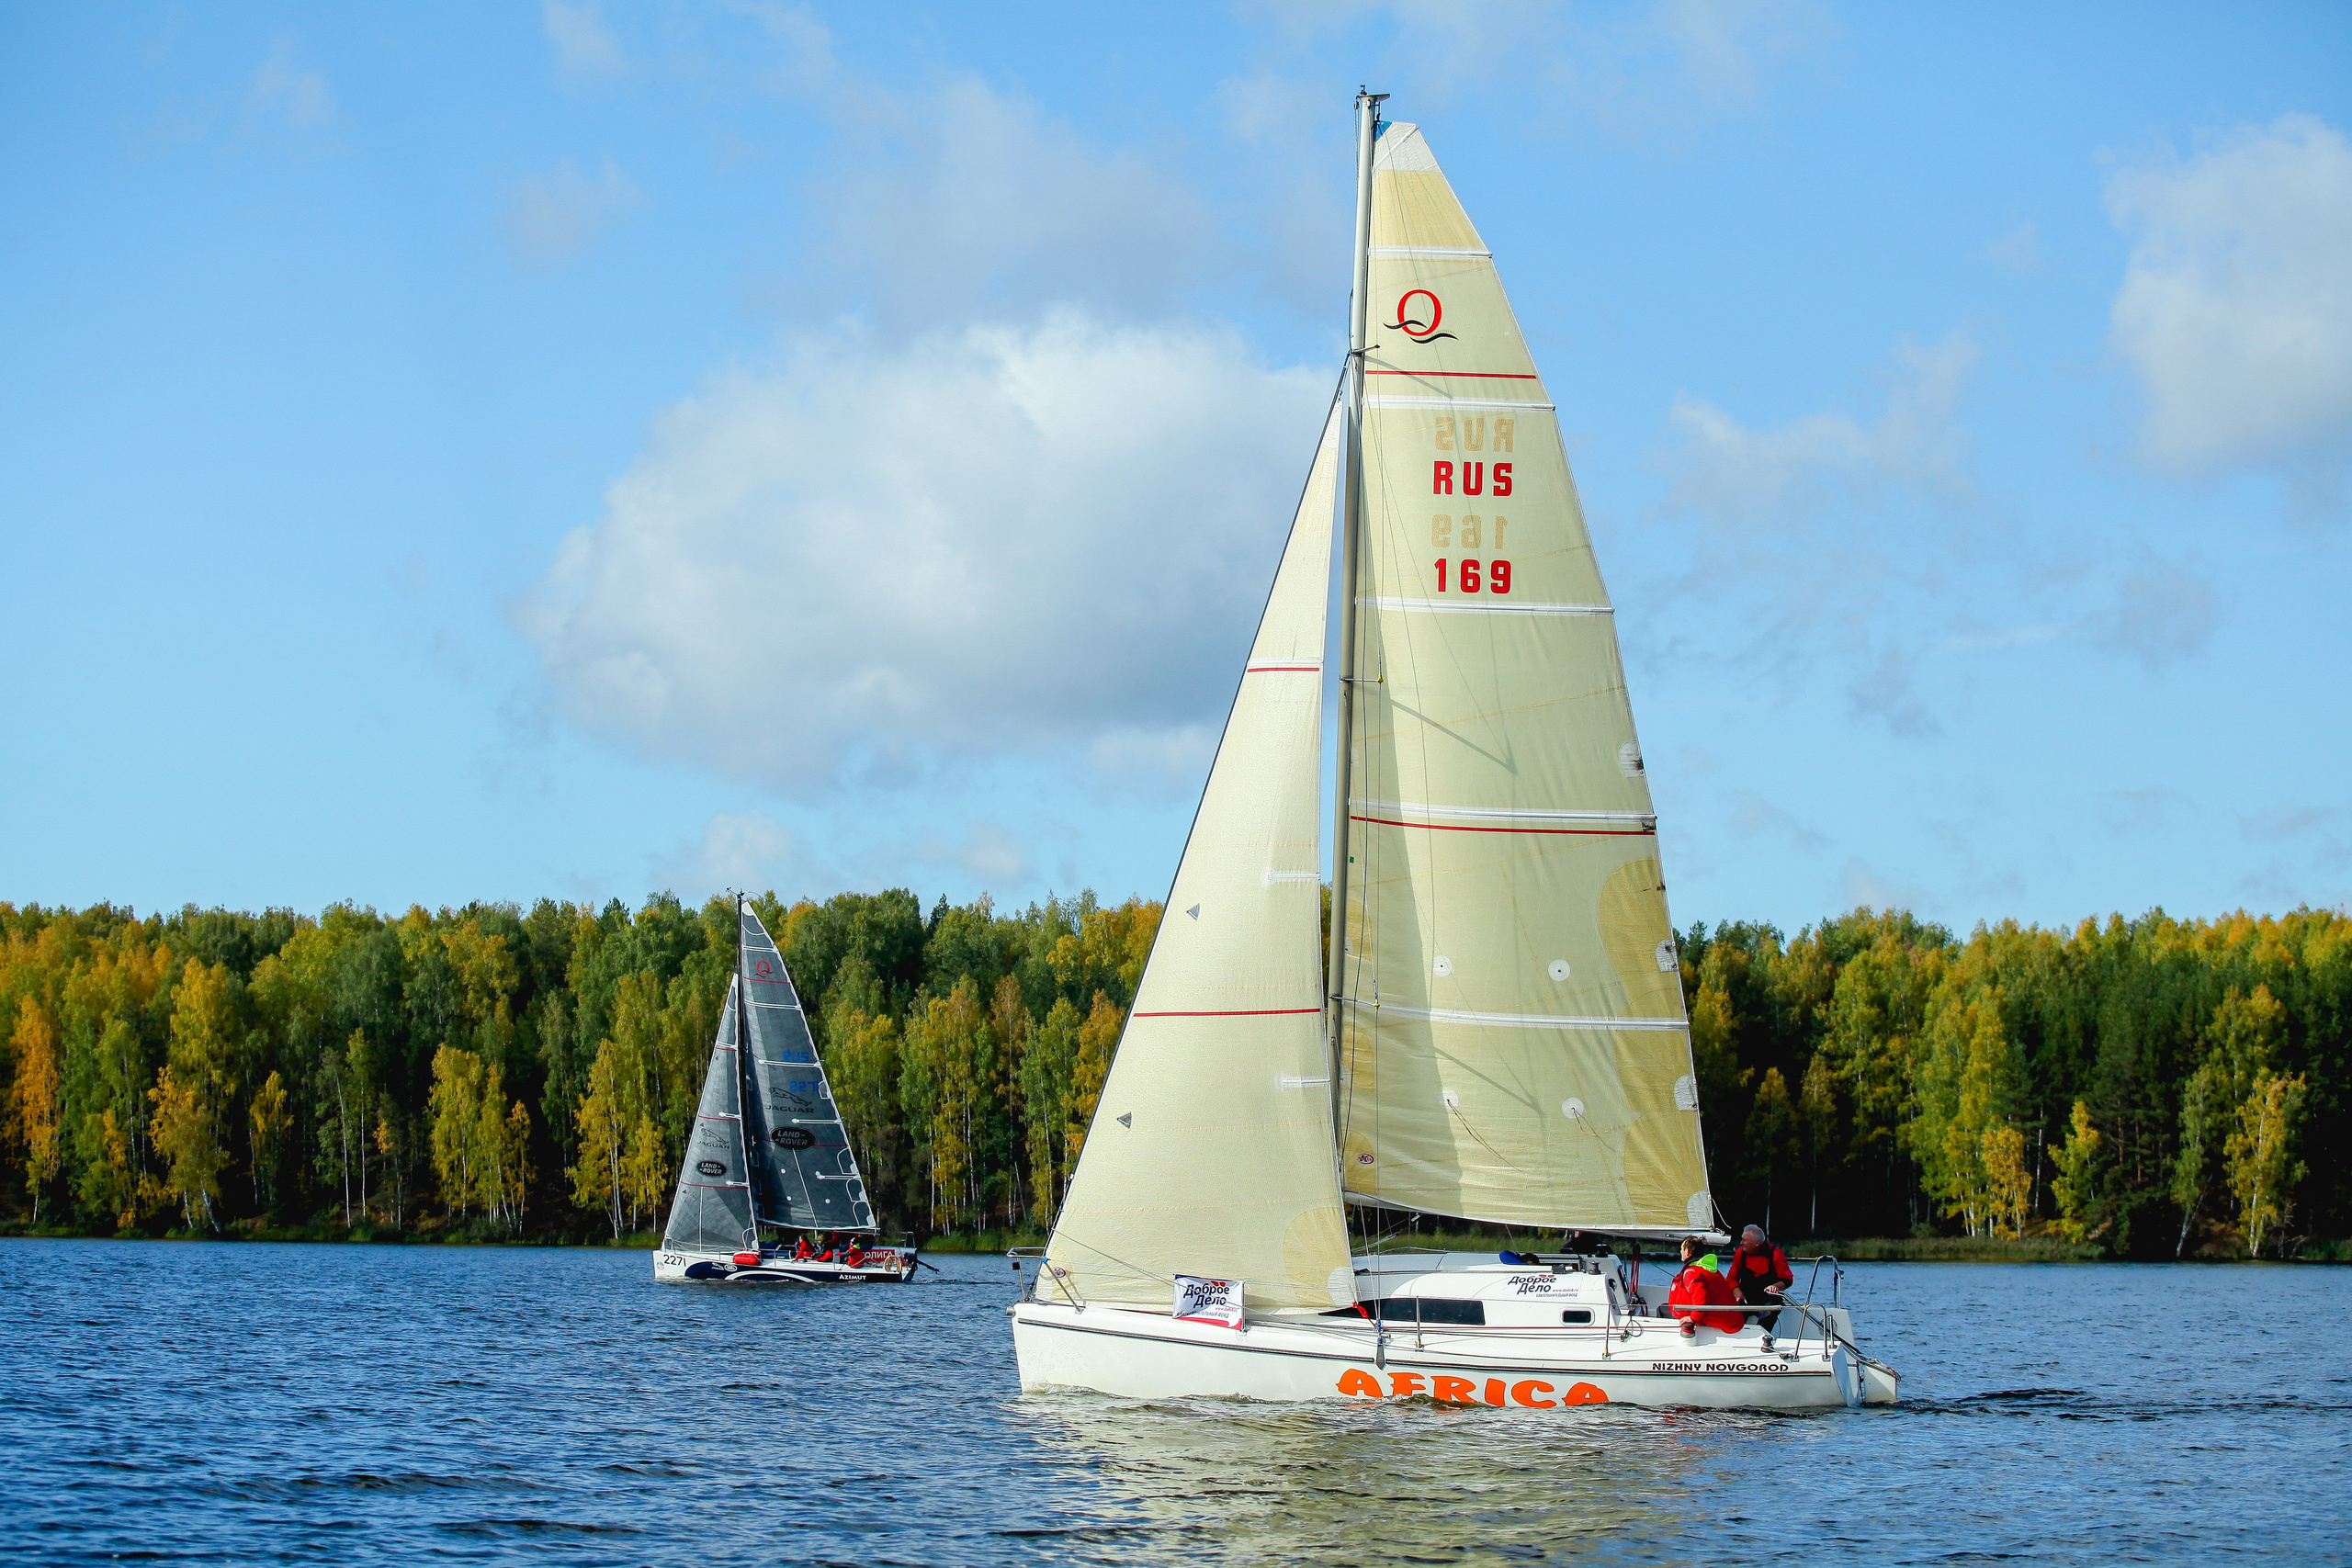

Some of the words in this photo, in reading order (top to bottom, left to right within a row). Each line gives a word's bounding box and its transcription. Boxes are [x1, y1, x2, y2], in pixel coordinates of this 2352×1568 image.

[1433, 461, 1513, 497] RUS
[1433, 558, 1511, 594] 169
[765, 1105, 815, 1114] JAGUAR
[696, 1140, 730, 1150] JAGUAR
[663, 1254, 686, 1268] 2271
[1508, 1274, 1557, 1286] Доброе
[1183, 1283, 1230, 1299] Доброе
[1516, 1283, 1552, 1295] Дело
[1193, 1294, 1227, 1309] Дело
[1652, 1362, 1702, 1371] NIZHNY
[1706, 1363, 1789, 1372] NOVGOROD
[1335, 1368, 1610, 1409] AFRICA
